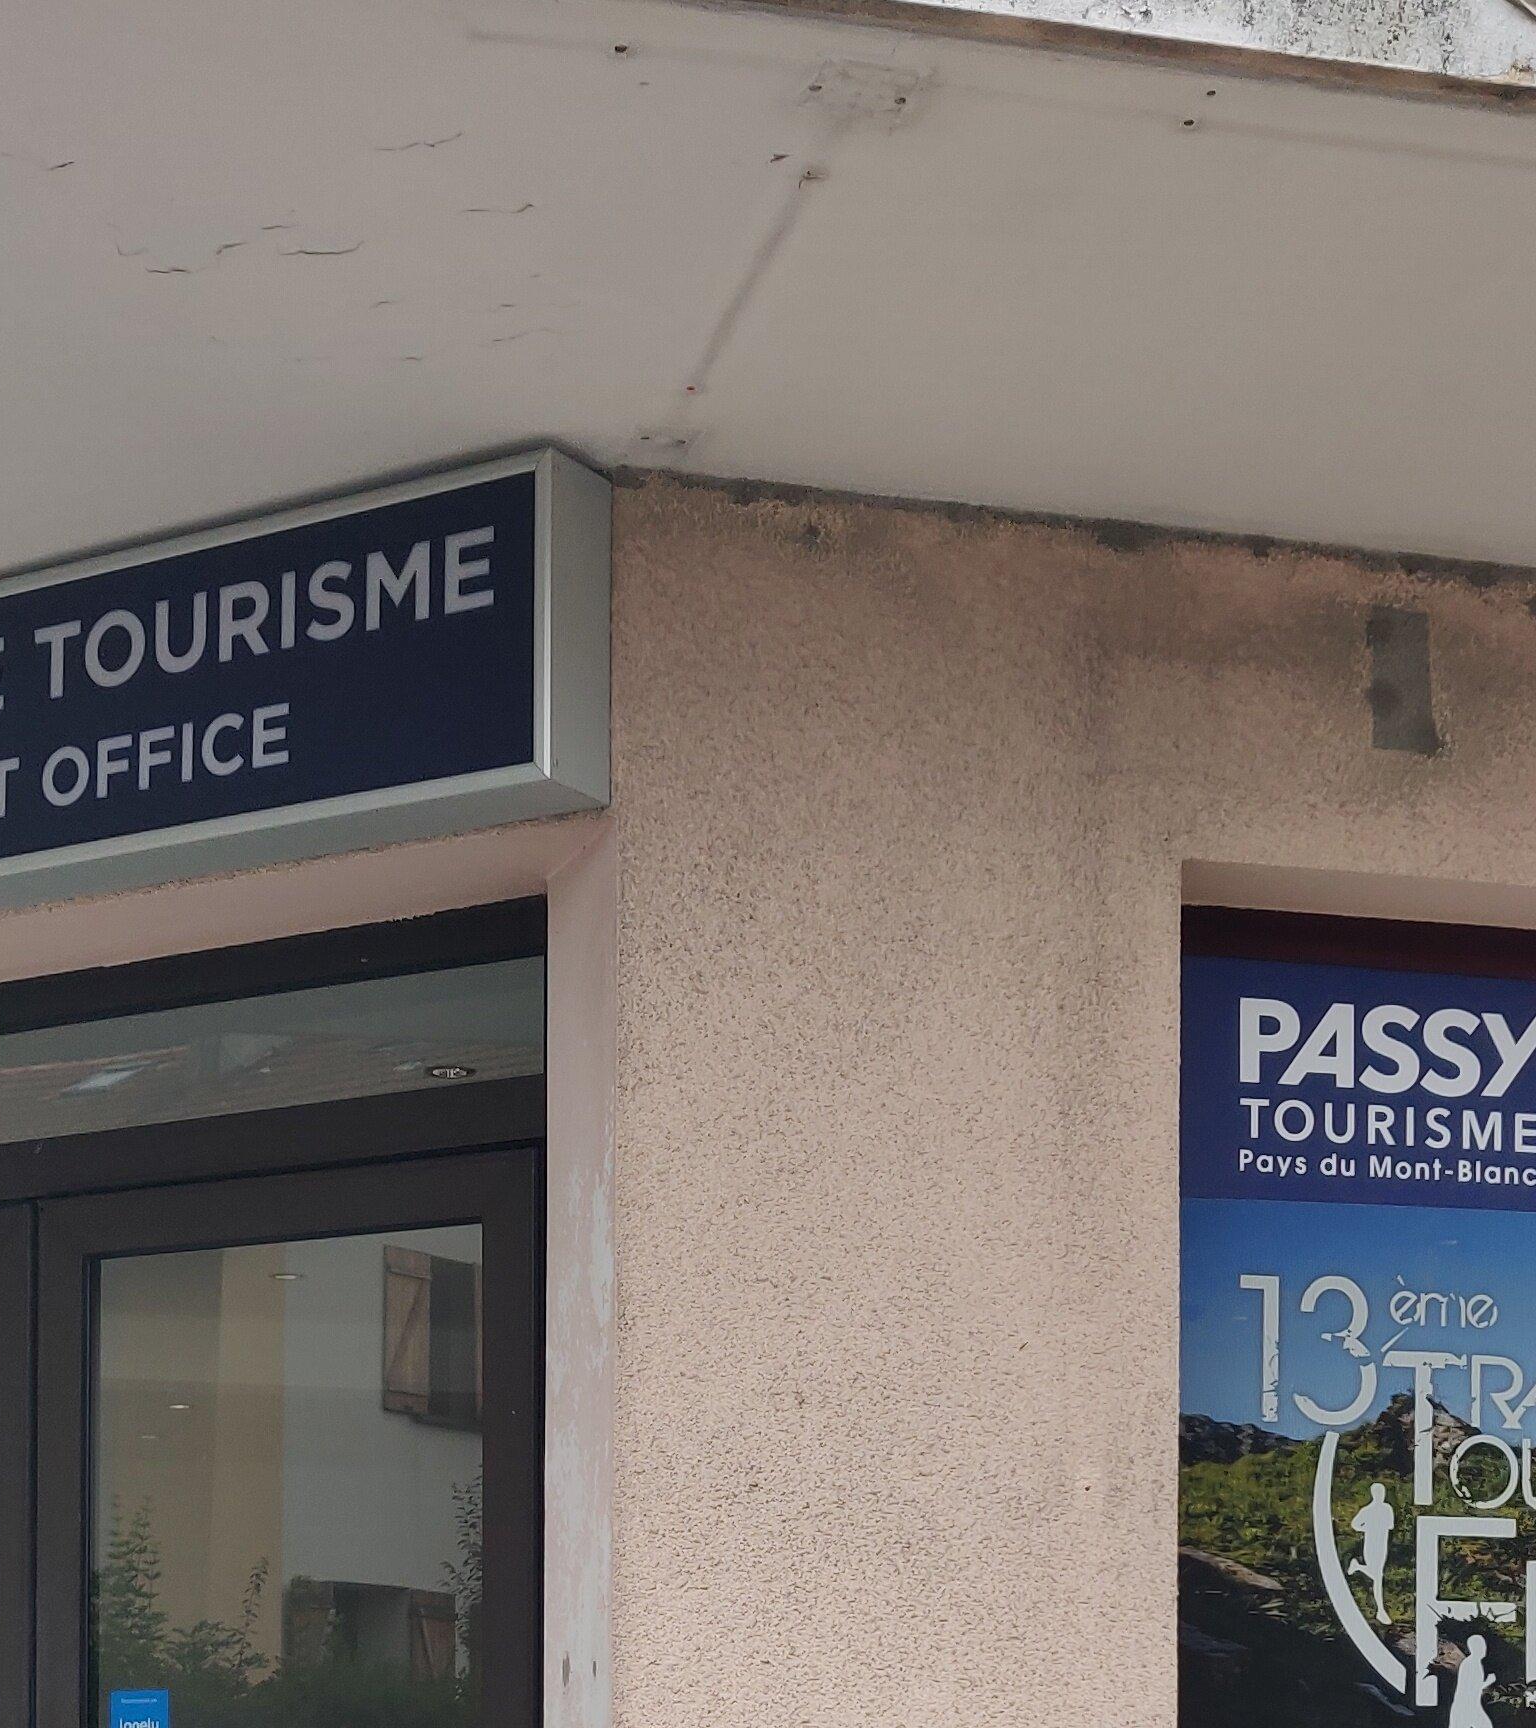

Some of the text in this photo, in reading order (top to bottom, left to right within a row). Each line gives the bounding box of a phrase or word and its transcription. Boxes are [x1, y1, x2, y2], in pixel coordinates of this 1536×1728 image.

[33, 525, 496, 702] TOURISME
[41, 701, 292, 806] OFFICE
[1238, 1149, 1310, 1179] Pays
[1319, 1151, 1356, 1178] du
[1239, 1274, 1378, 1426] 13
